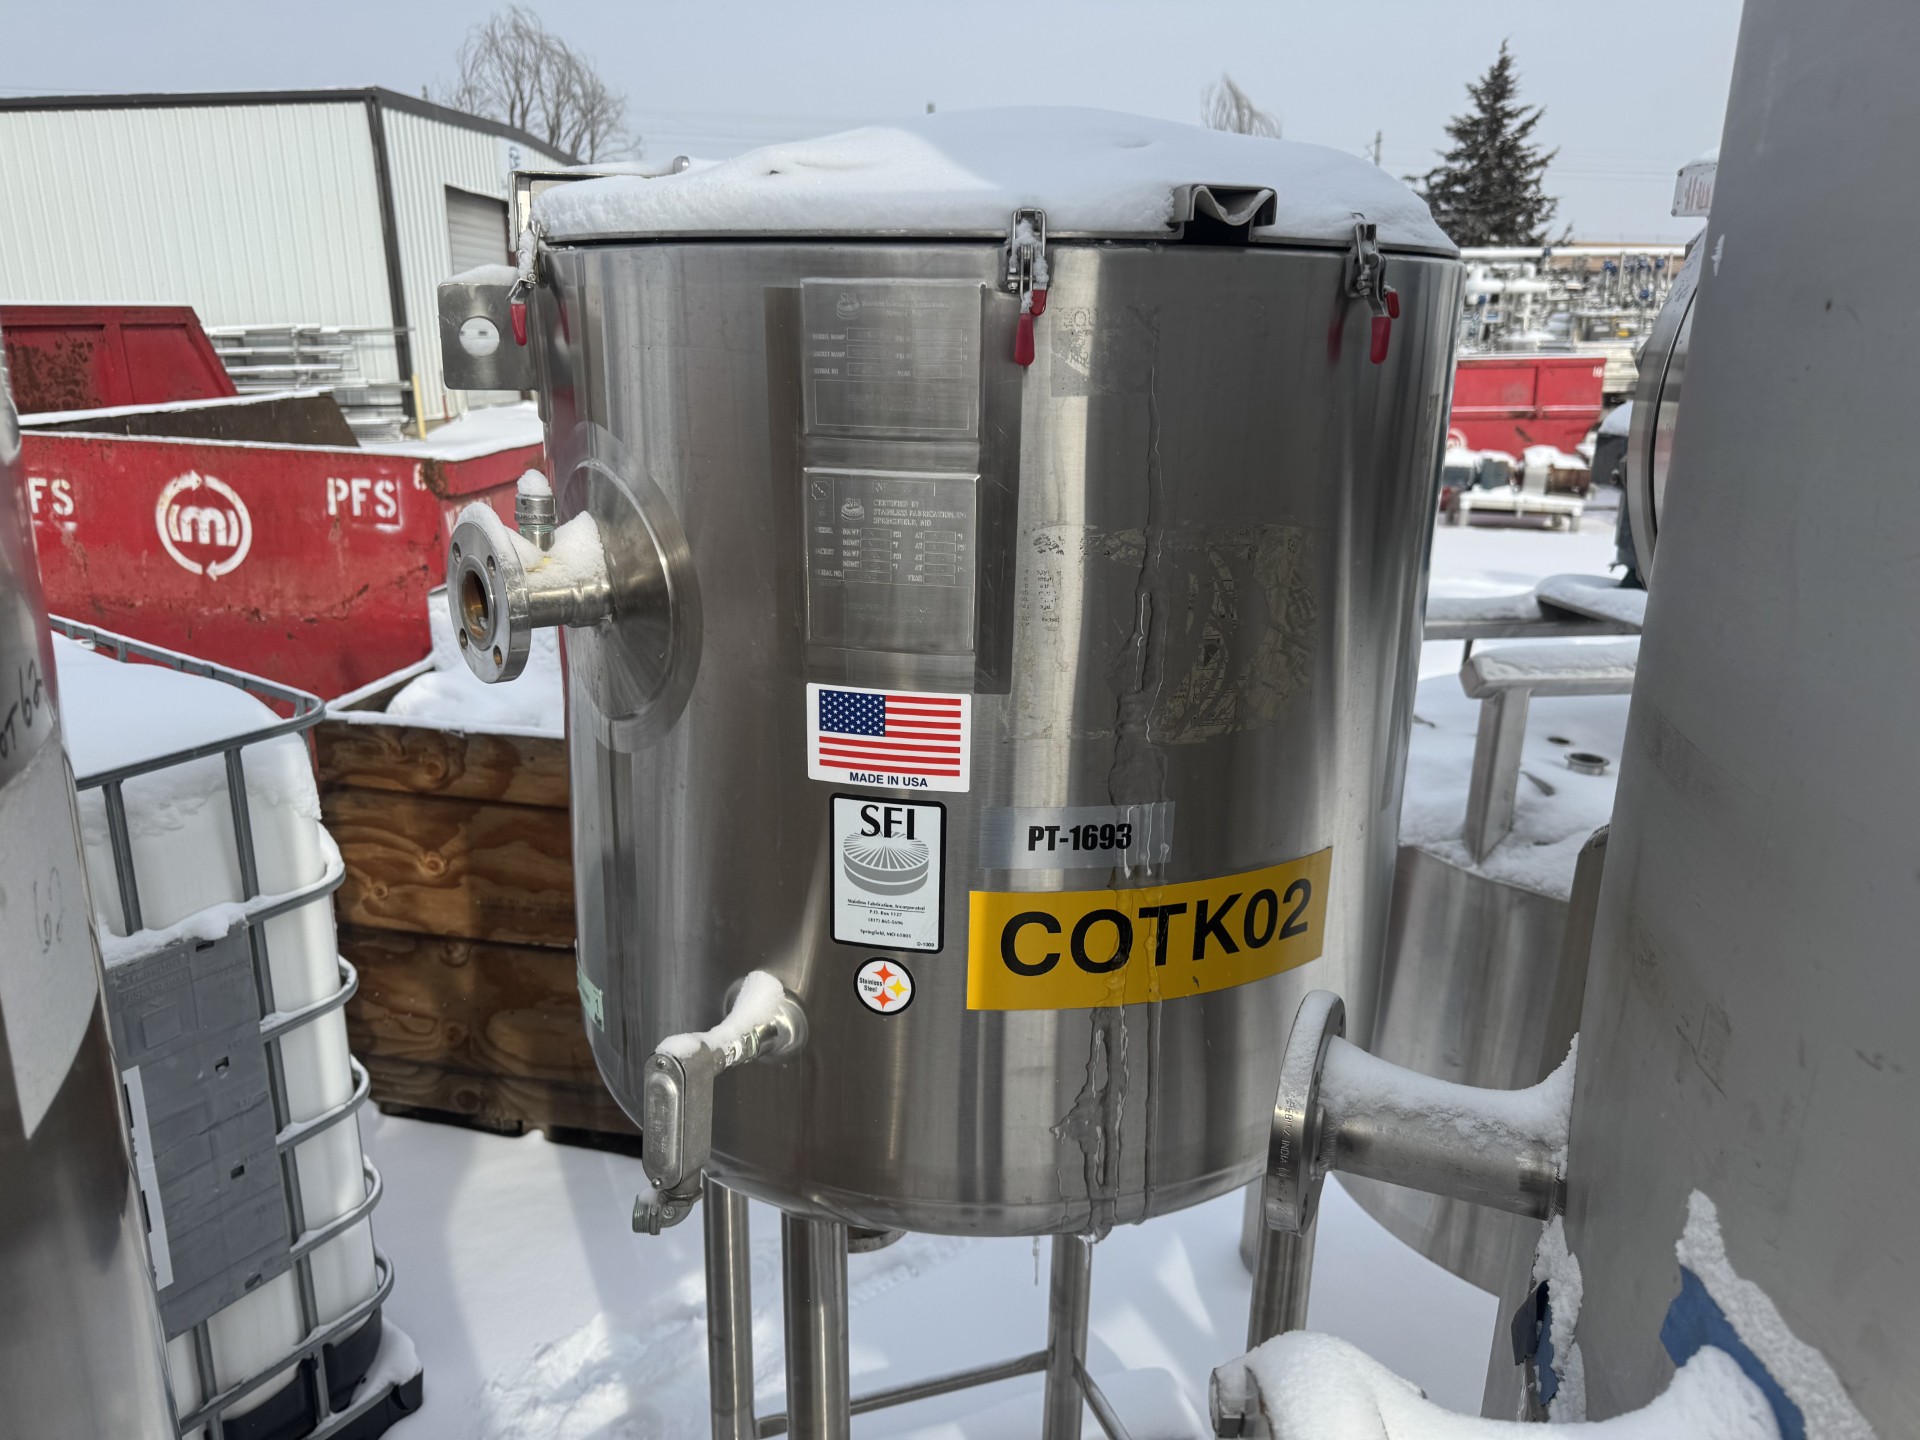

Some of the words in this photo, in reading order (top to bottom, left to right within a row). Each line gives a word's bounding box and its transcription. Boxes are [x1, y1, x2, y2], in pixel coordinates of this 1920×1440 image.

[327, 477, 397, 518] PFS
[849, 771, 884, 785] MADE
[887, 775, 899, 786] IN
[902, 776, 928, 788] USA
[860, 804, 915, 840] SFI
[1028, 823, 1132, 851] PT-1693
[847, 898, 867, 906] Stainless
[859, 928, 886, 937] Springfield,
[1000, 878, 1312, 977] COTK02
[859, 977, 883, 987] Stainless
[863, 984, 878, 993] Steel
